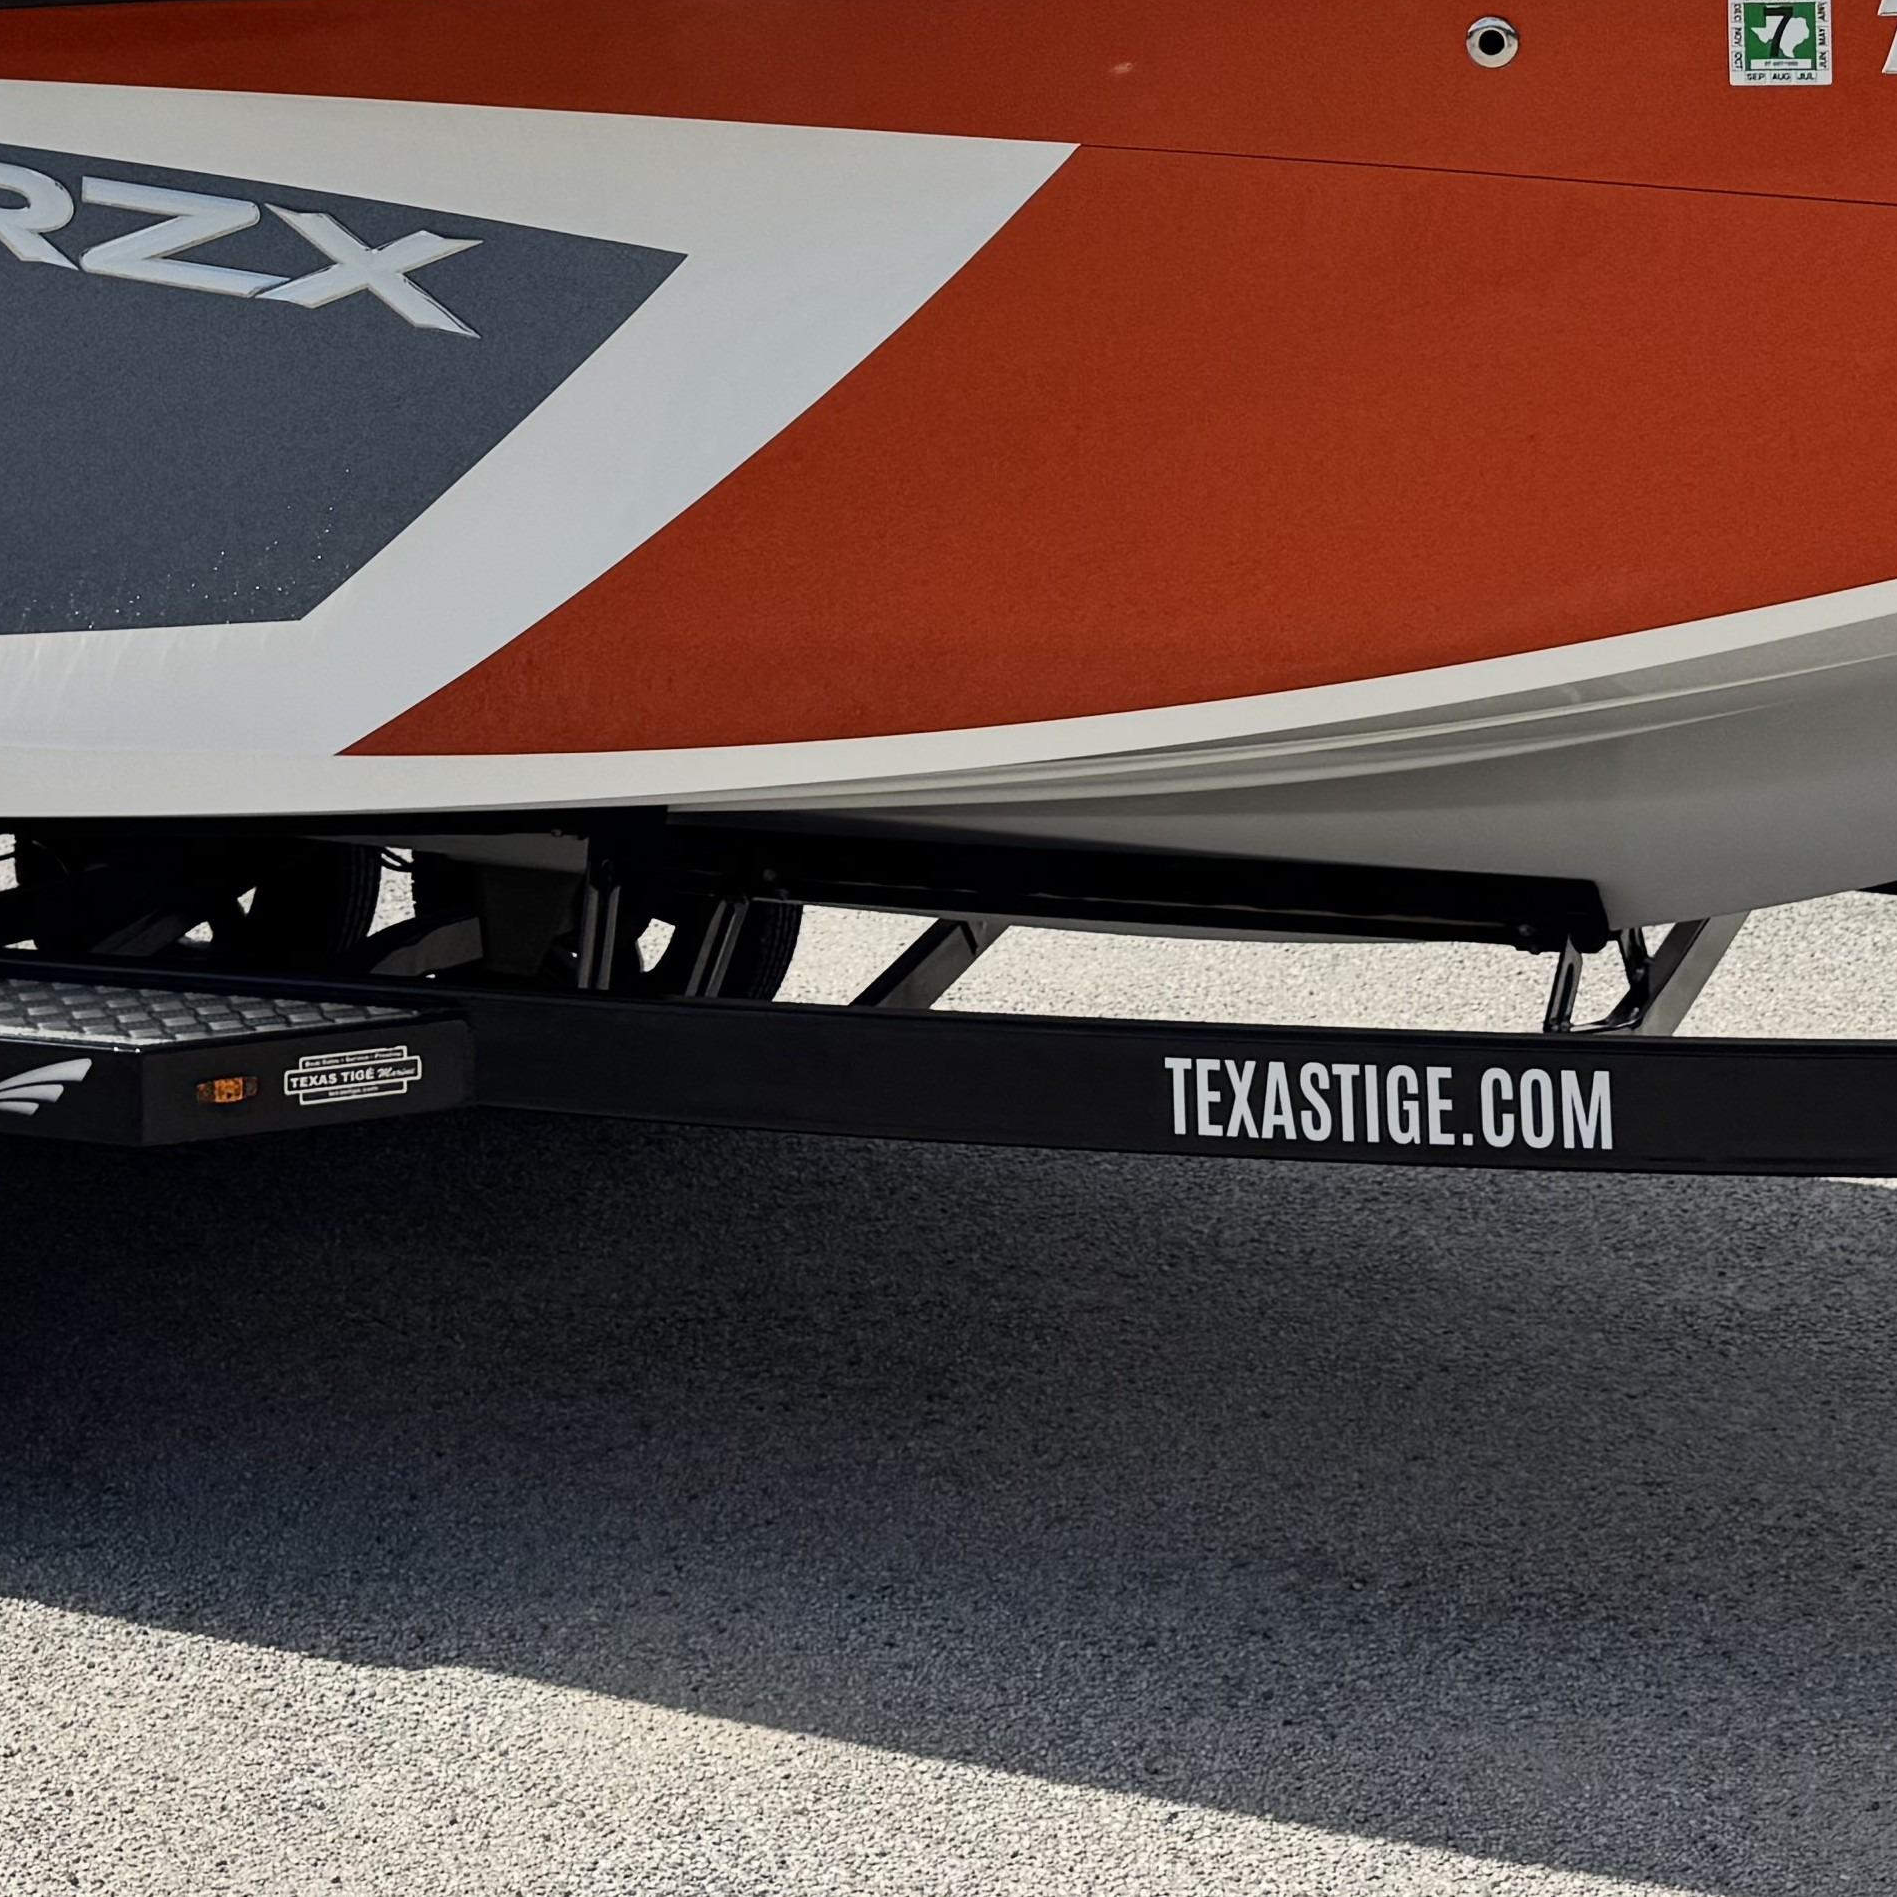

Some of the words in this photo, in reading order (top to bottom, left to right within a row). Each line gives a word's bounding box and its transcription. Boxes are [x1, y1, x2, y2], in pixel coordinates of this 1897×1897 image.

[1764, 6, 1793, 59] 7
[290, 1073, 338, 1088] TEXAS
[341, 1067, 375, 1083] TIGÉ
[1164, 1056, 1613, 1151] TEXASTIGE.COM
